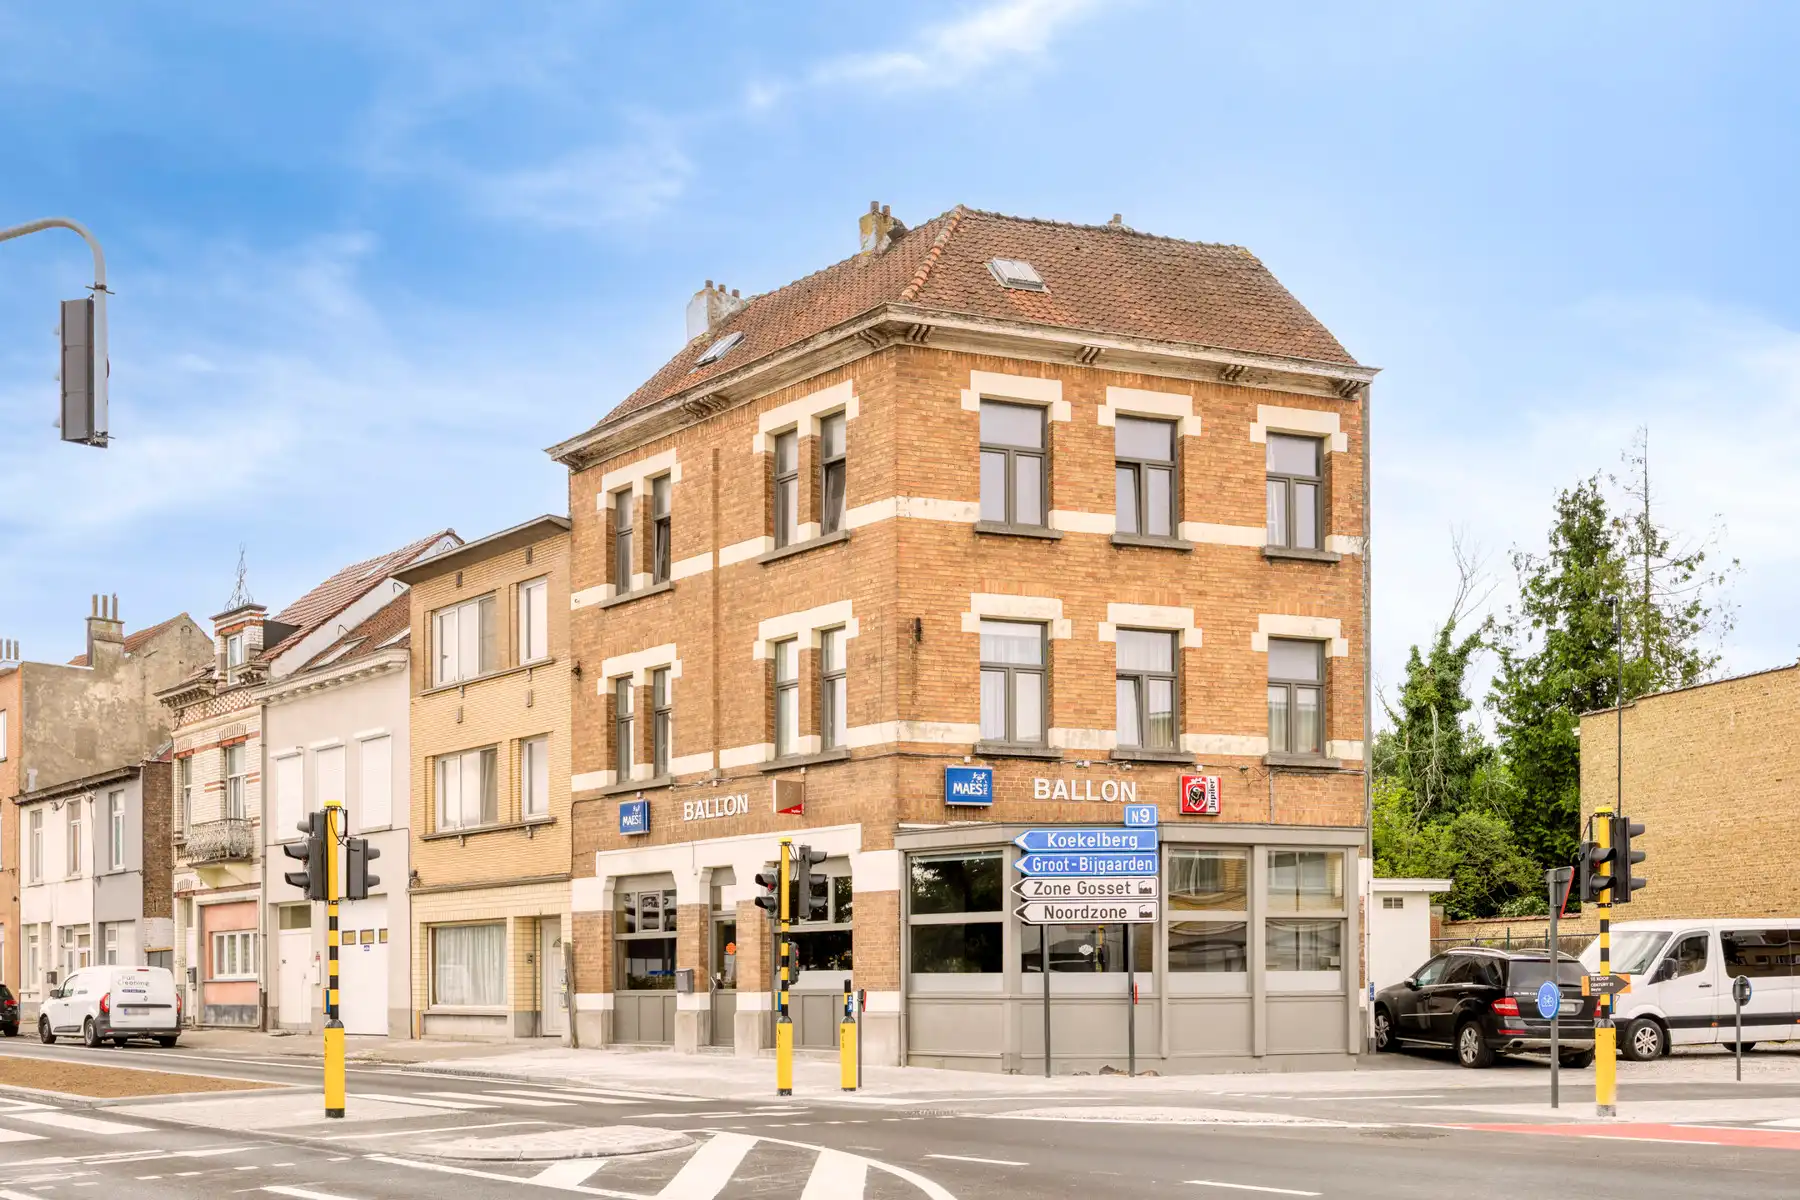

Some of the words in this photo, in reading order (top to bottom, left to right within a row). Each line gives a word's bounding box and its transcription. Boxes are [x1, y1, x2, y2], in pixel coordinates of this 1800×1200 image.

[952, 781, 983, 796] MAES
[1033, 777, 1137, 802] BALLON
[1208, 778, 1217, 811] Jupiler
[683, 793, 749, 821] BALLON
[622, 814, 639, 826] MAES
[1131, 808, 1150, 823] N9
[1047, 832, 1138, 850] Koekelberg
[1032, 856, 1153, 875] Groot-Bijgaarden
[1033, 881, 1071, 895] Zone
[1077, 880, 1132, 895] Gosset
[1044, 904, 1128, 919] Noordzone
